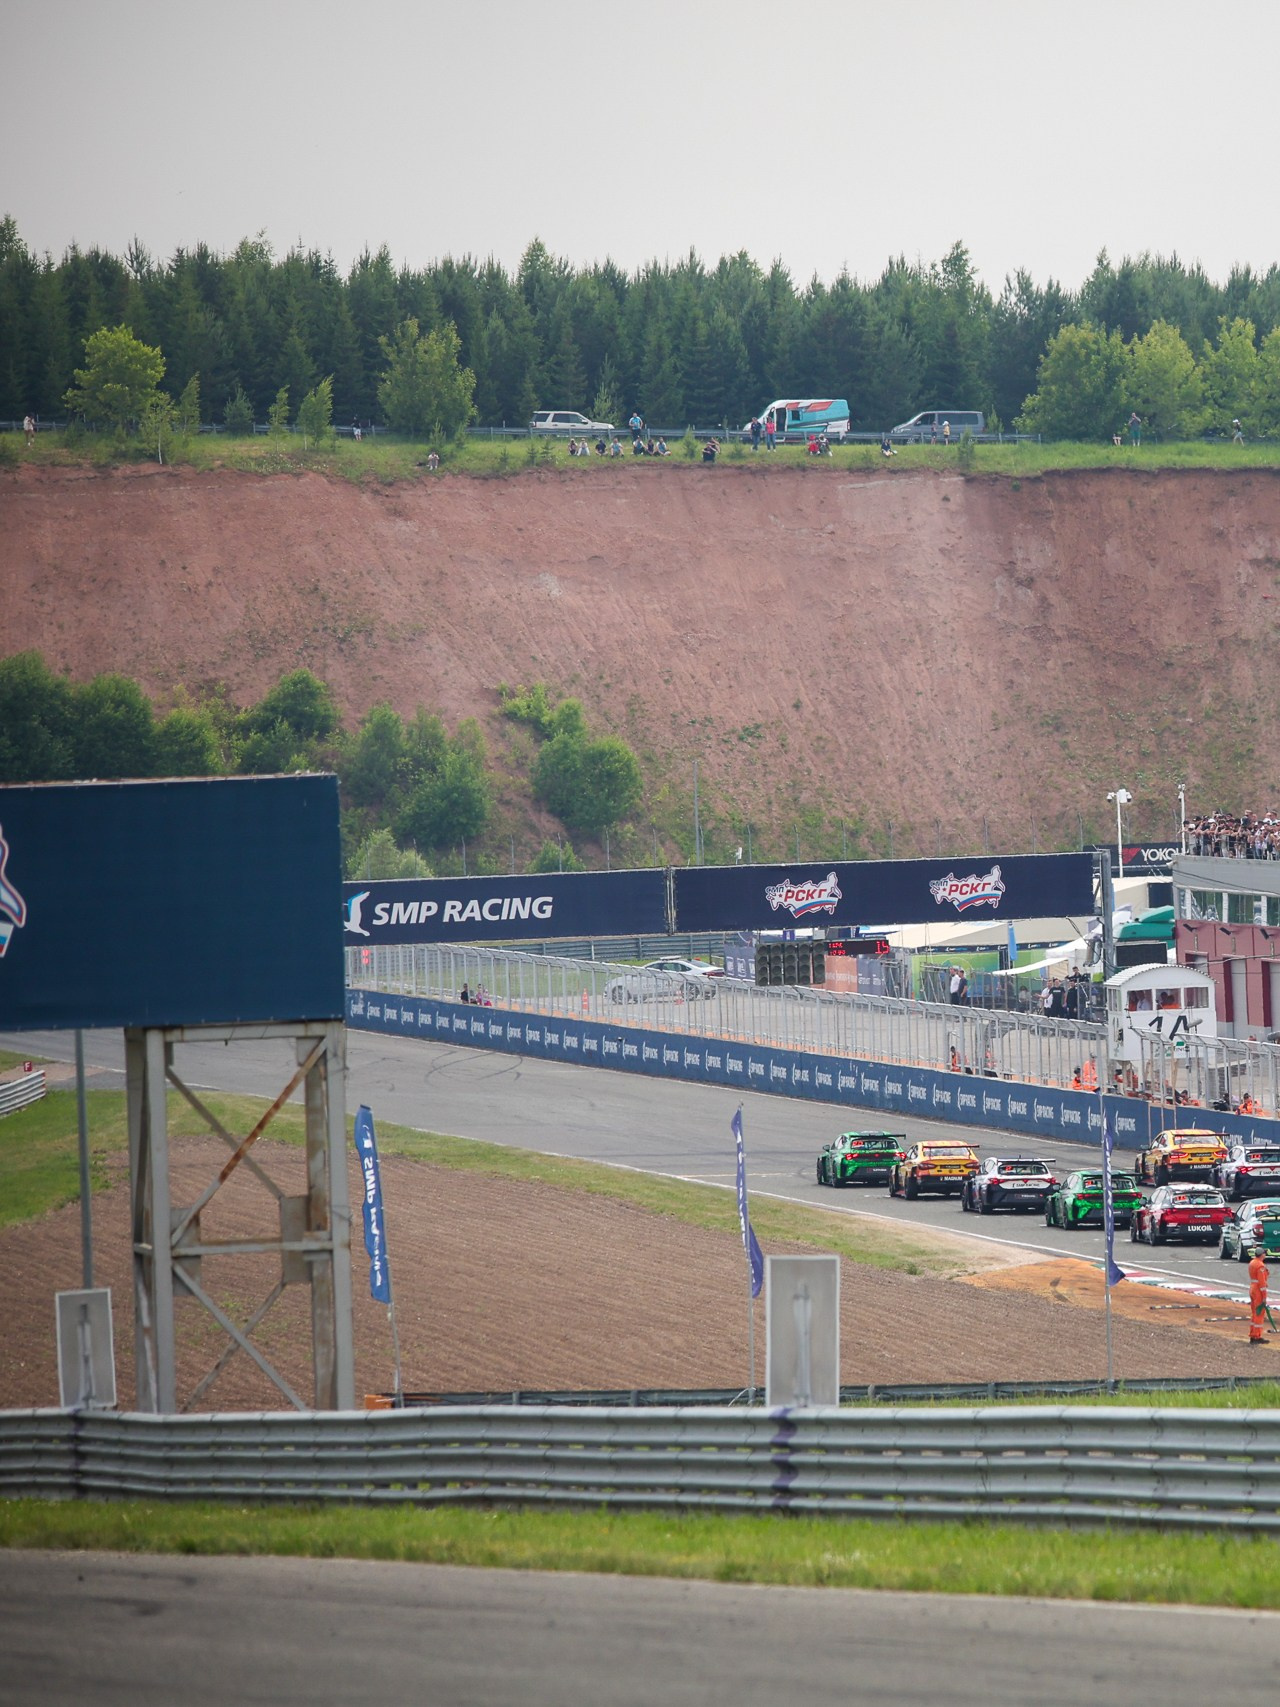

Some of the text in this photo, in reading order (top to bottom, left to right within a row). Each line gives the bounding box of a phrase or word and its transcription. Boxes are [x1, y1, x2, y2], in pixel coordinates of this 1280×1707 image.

[784, 889, 827, 902] РСКГ
[948, 882, 992, 896] РСКГ
[372, 896, 554, 926] SMP RACING
